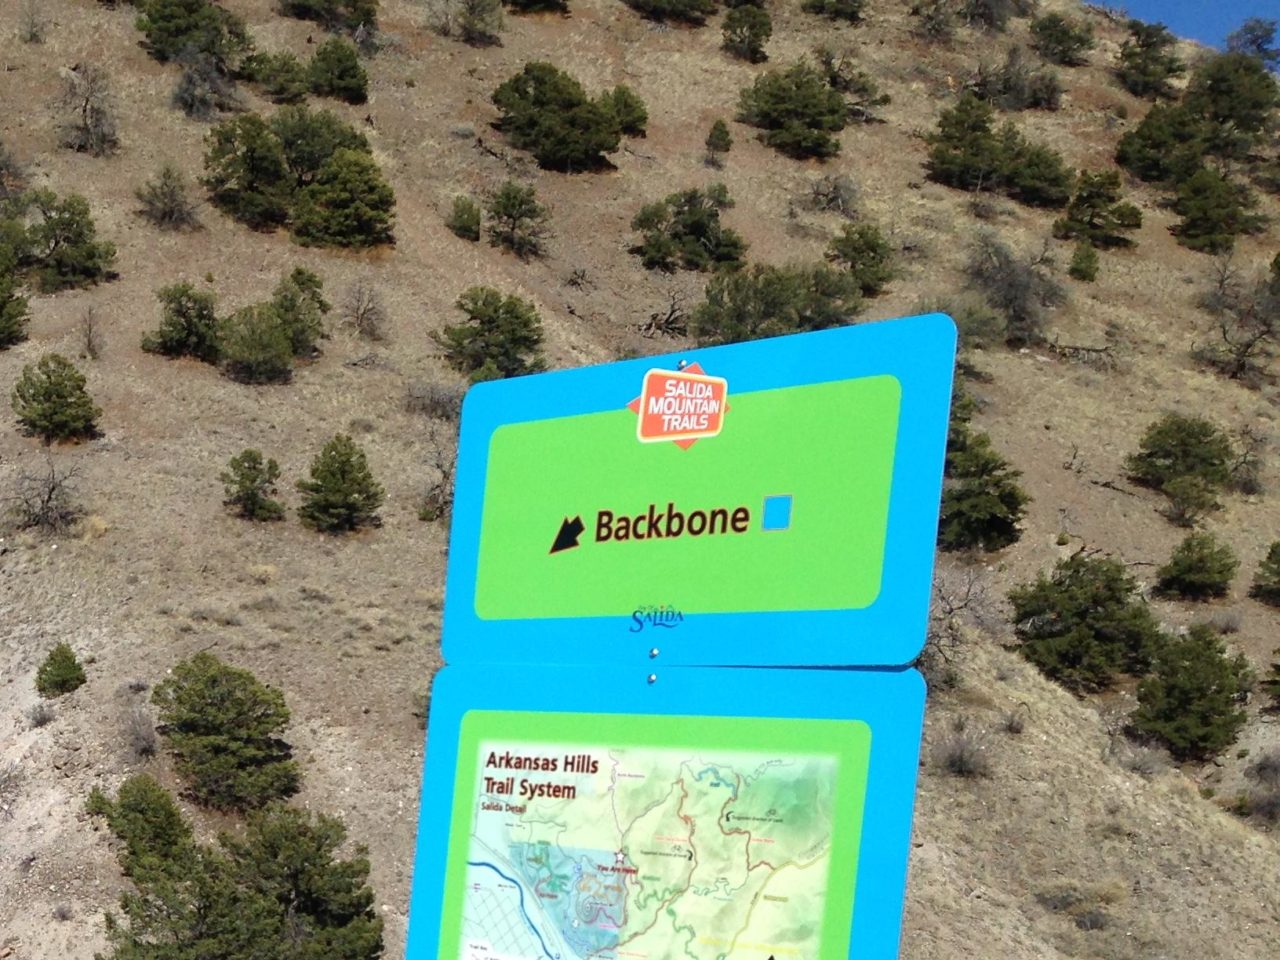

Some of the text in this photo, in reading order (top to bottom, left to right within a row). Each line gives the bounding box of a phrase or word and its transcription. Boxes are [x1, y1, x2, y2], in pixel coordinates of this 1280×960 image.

[664, 380, 713, 399] SALIDA
[648, 396, 720, 415] MOUNTAIN
[662, 414, 709, 432] TRAILS
[595, 503, 750, 542] Backbone
[486, 751, 599, 774] Arkansas Hills
[484, 777, 576, 800] Trail System
[481, 802, 527, 814] Salida Detail
